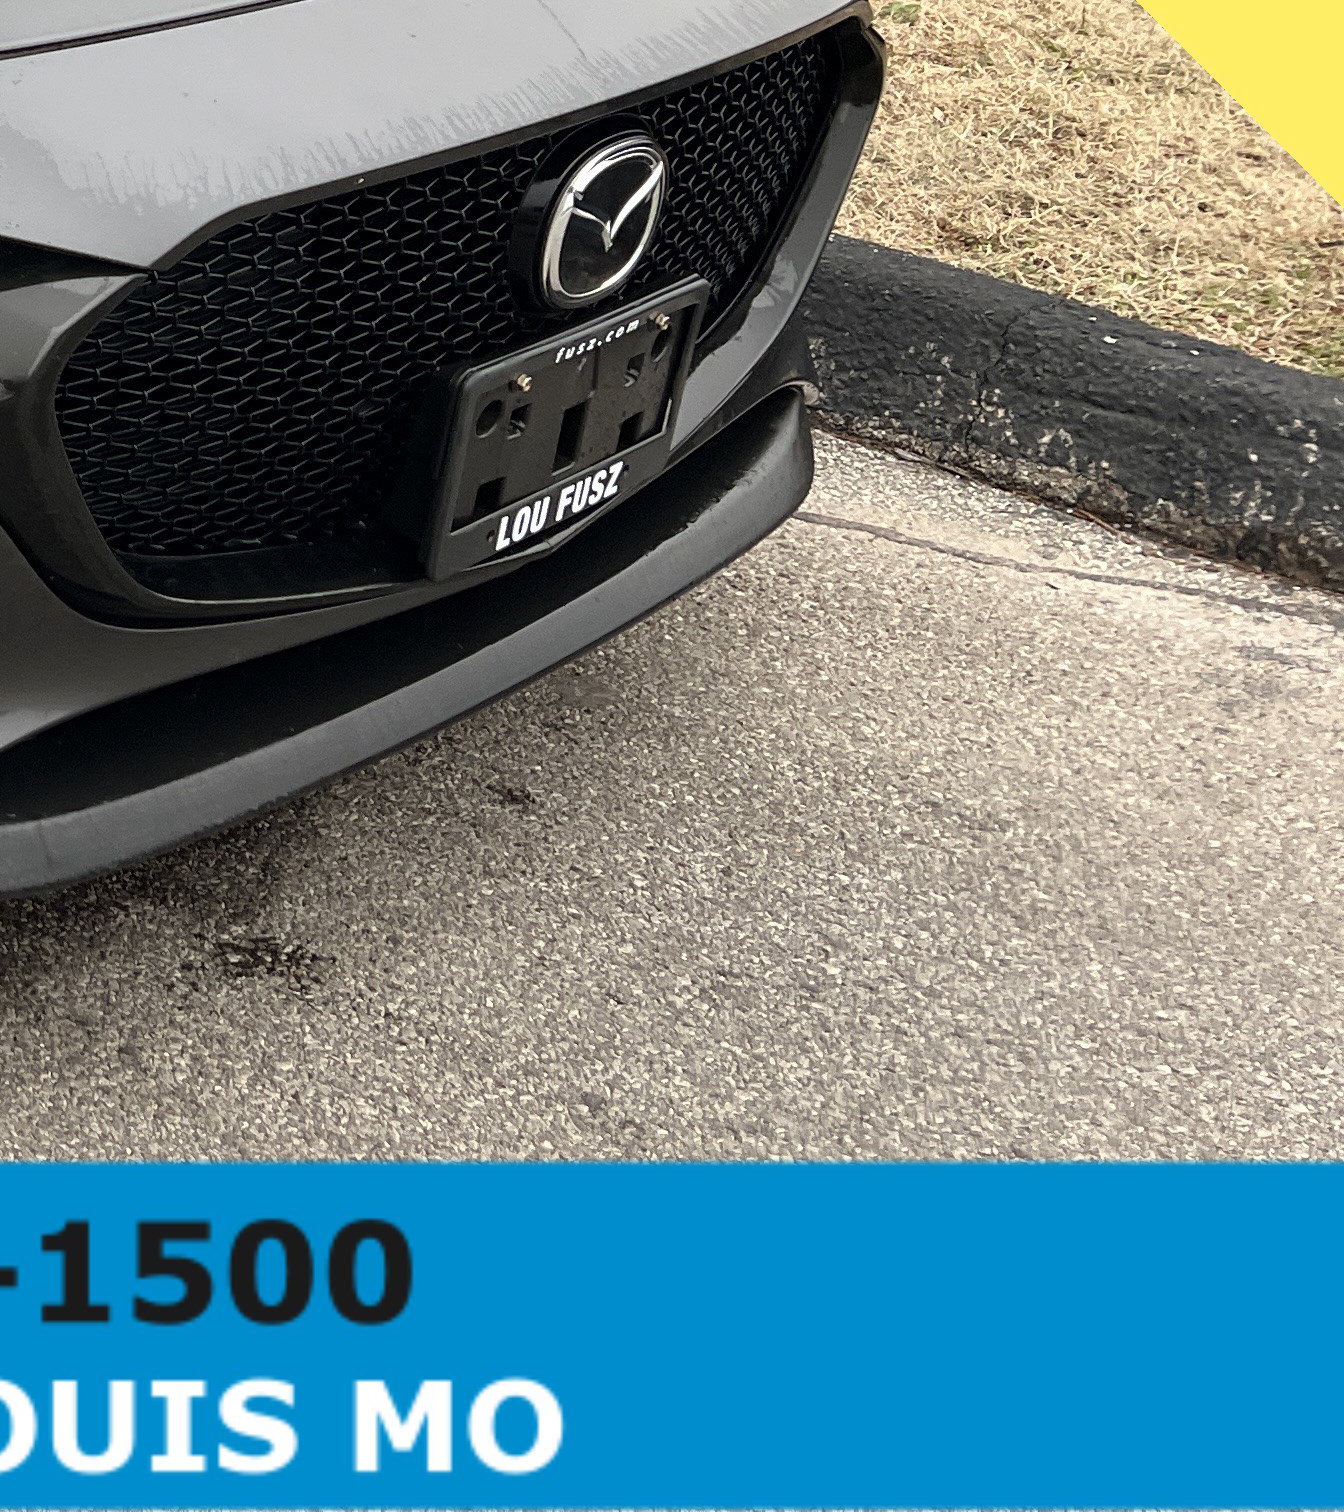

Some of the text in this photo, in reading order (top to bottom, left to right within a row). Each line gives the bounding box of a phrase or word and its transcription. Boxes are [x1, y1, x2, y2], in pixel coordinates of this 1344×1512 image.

[555, 319, 640, 364] fusz.com
[495, 461, 624, 551] LOU FUSZ
